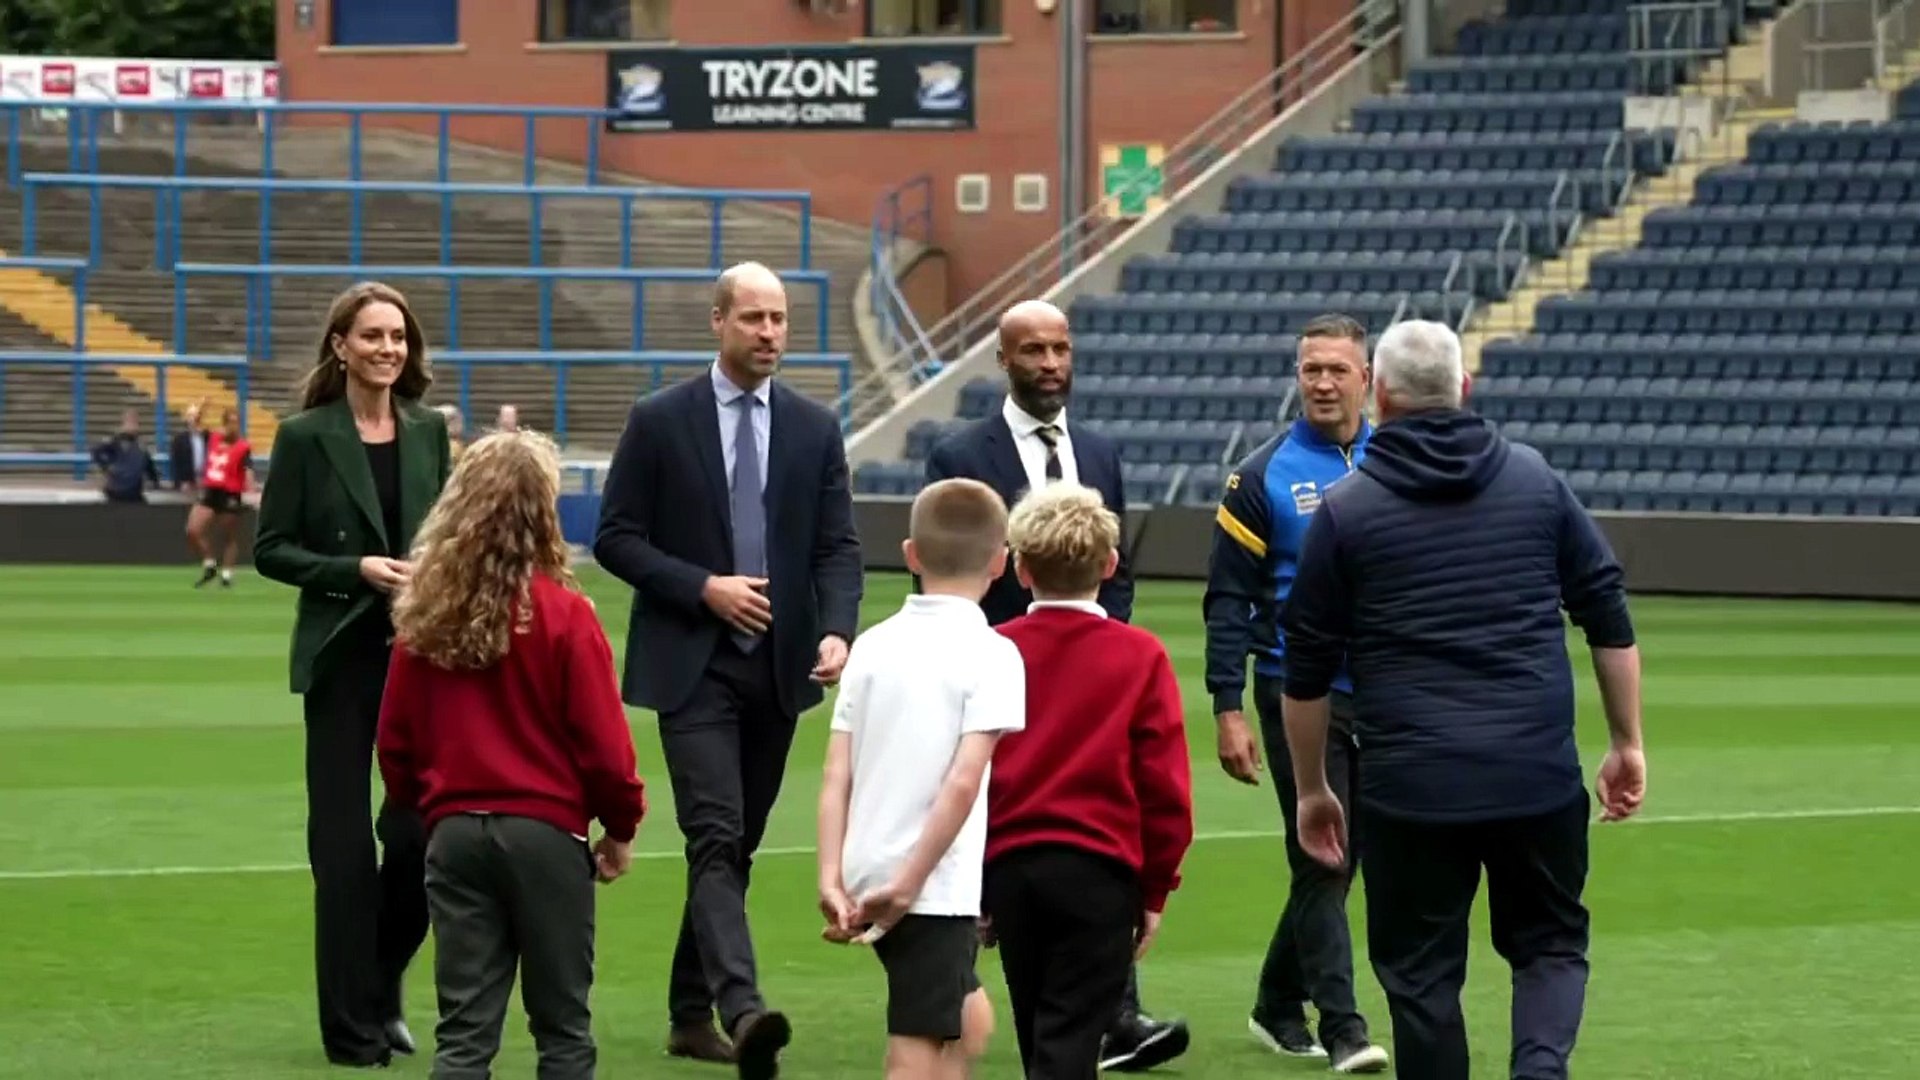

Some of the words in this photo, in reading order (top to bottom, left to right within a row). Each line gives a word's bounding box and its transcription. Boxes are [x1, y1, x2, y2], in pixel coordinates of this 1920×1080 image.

[702, 58, 879, 98] TRYZONE
[712, 103, 798, 124] LEARNING
[800, 102, 865, 123] CENTRE
